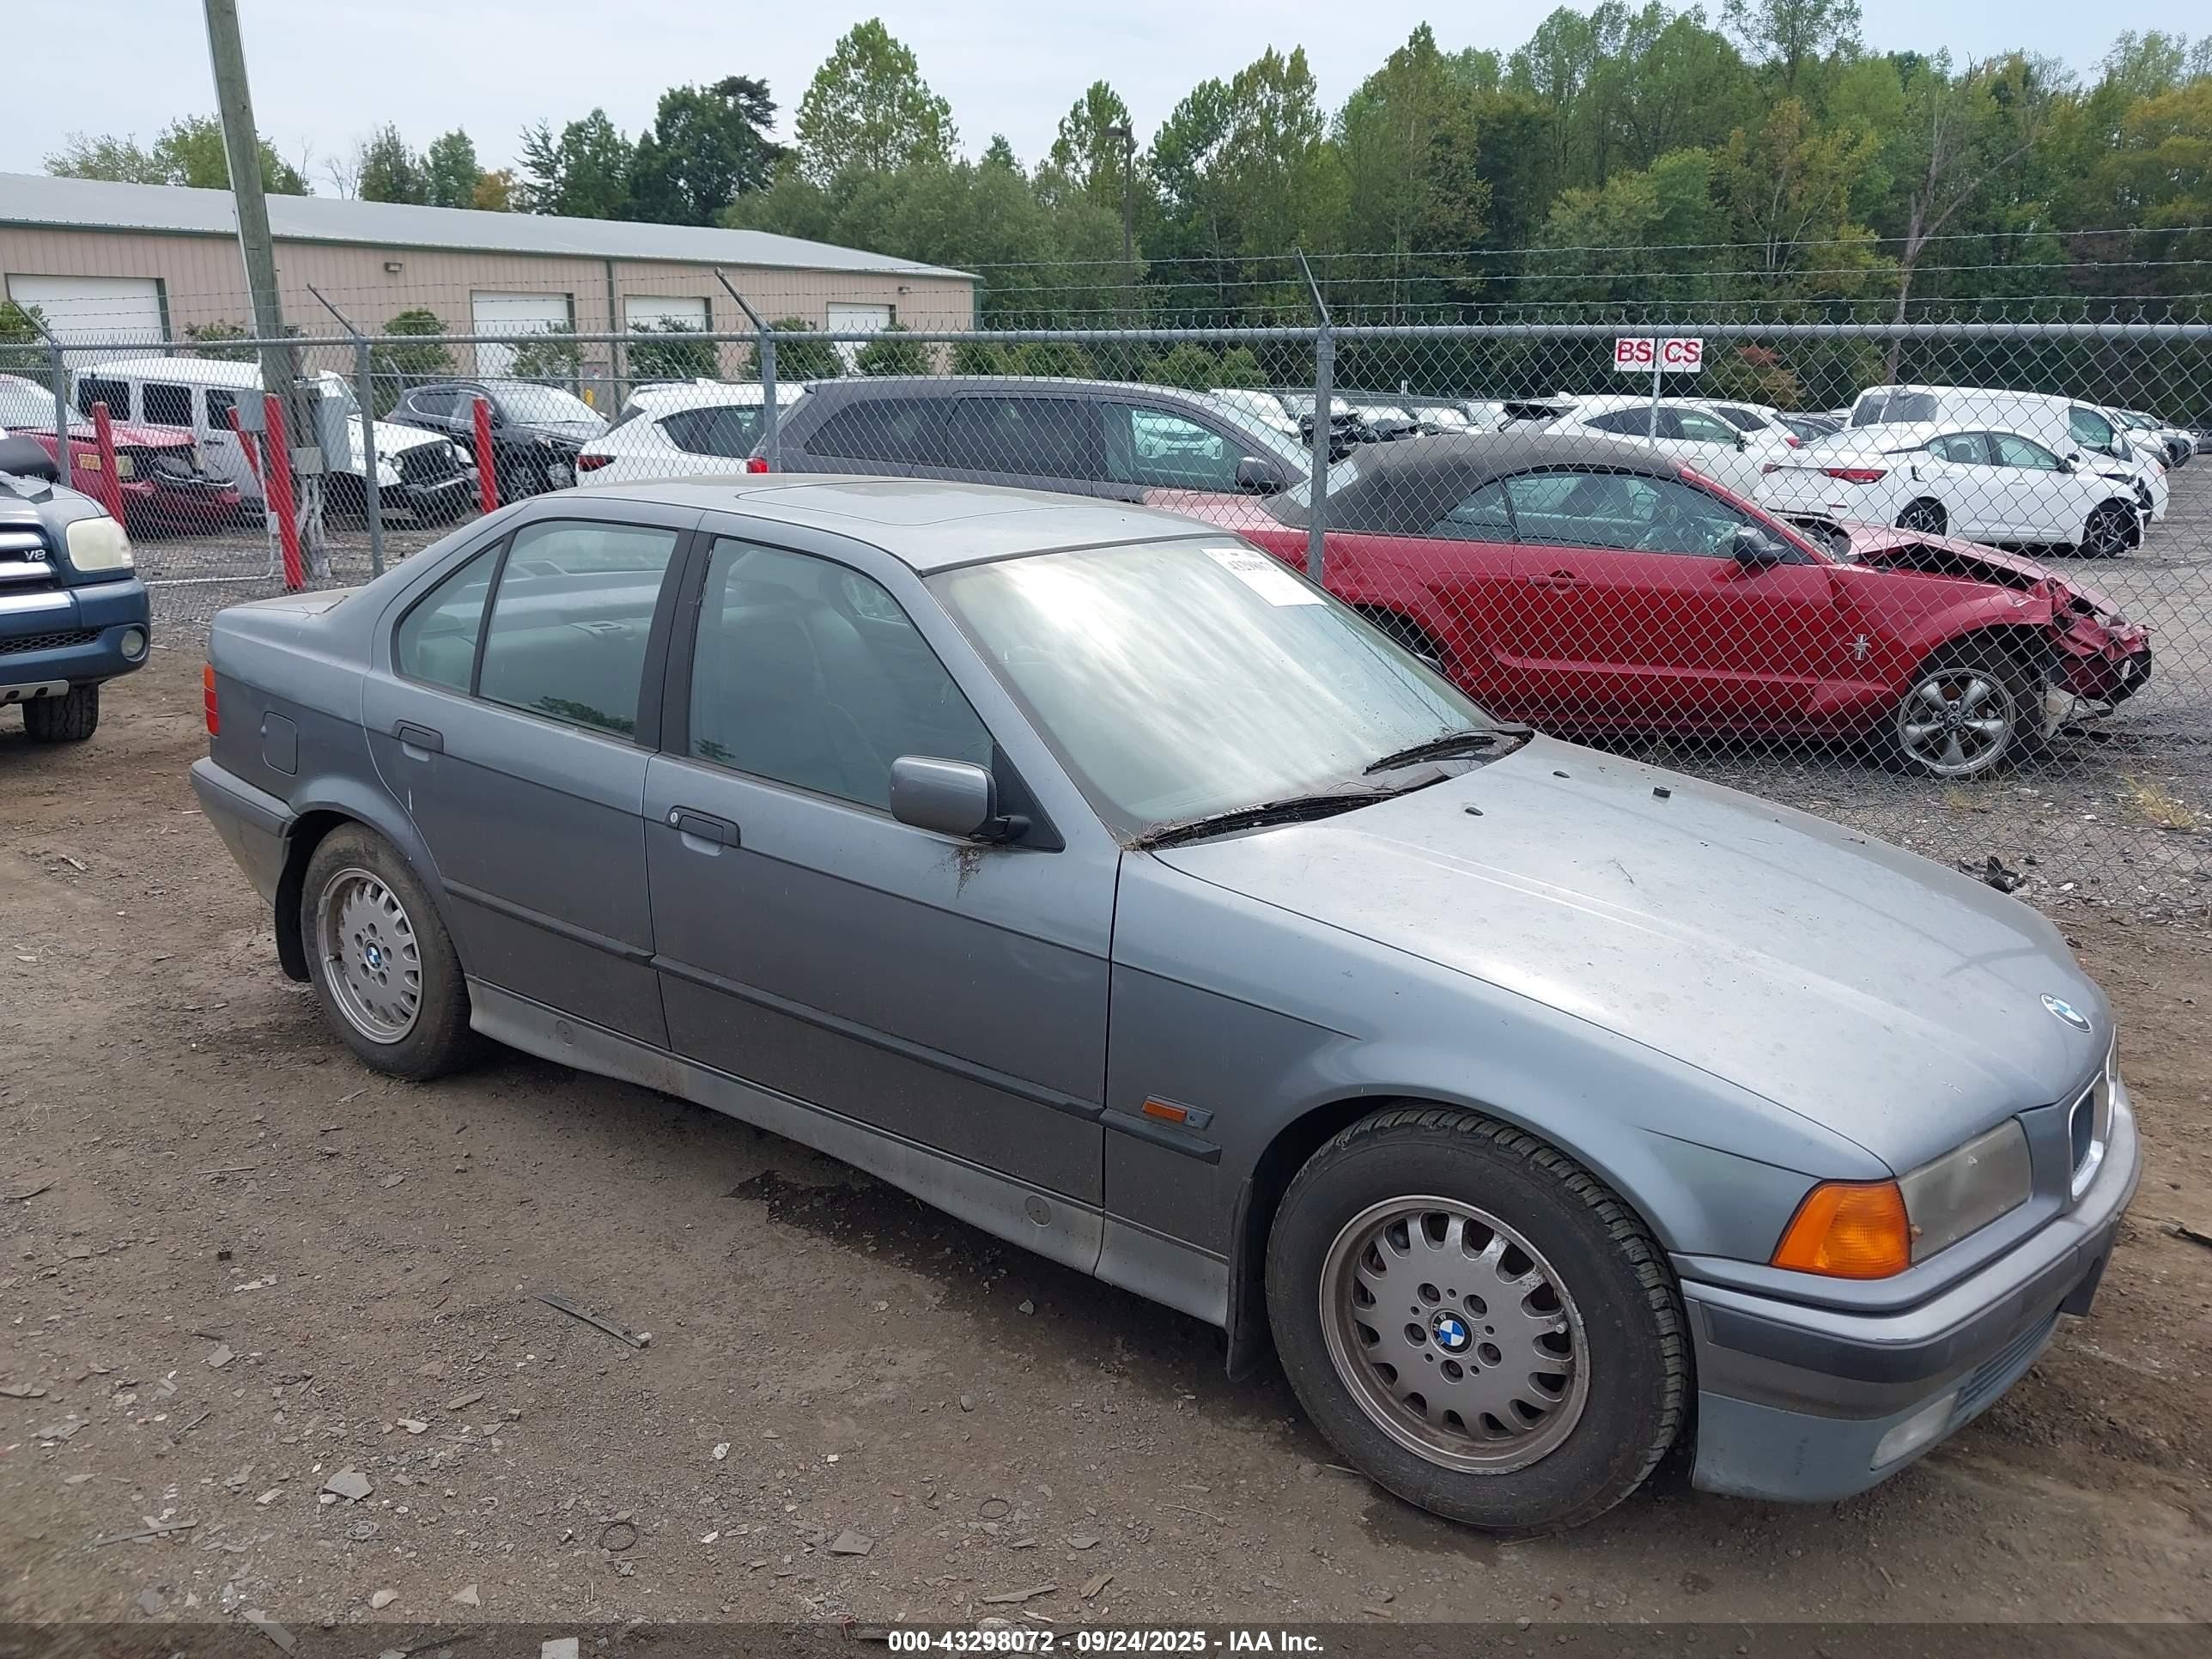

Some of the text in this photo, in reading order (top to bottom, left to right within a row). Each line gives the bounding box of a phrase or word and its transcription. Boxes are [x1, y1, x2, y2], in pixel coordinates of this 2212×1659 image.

[1617, 341, 1652, 362] BS
[1664, 342, 1700, 362] CS
[24, 549, 46, 562] V8
